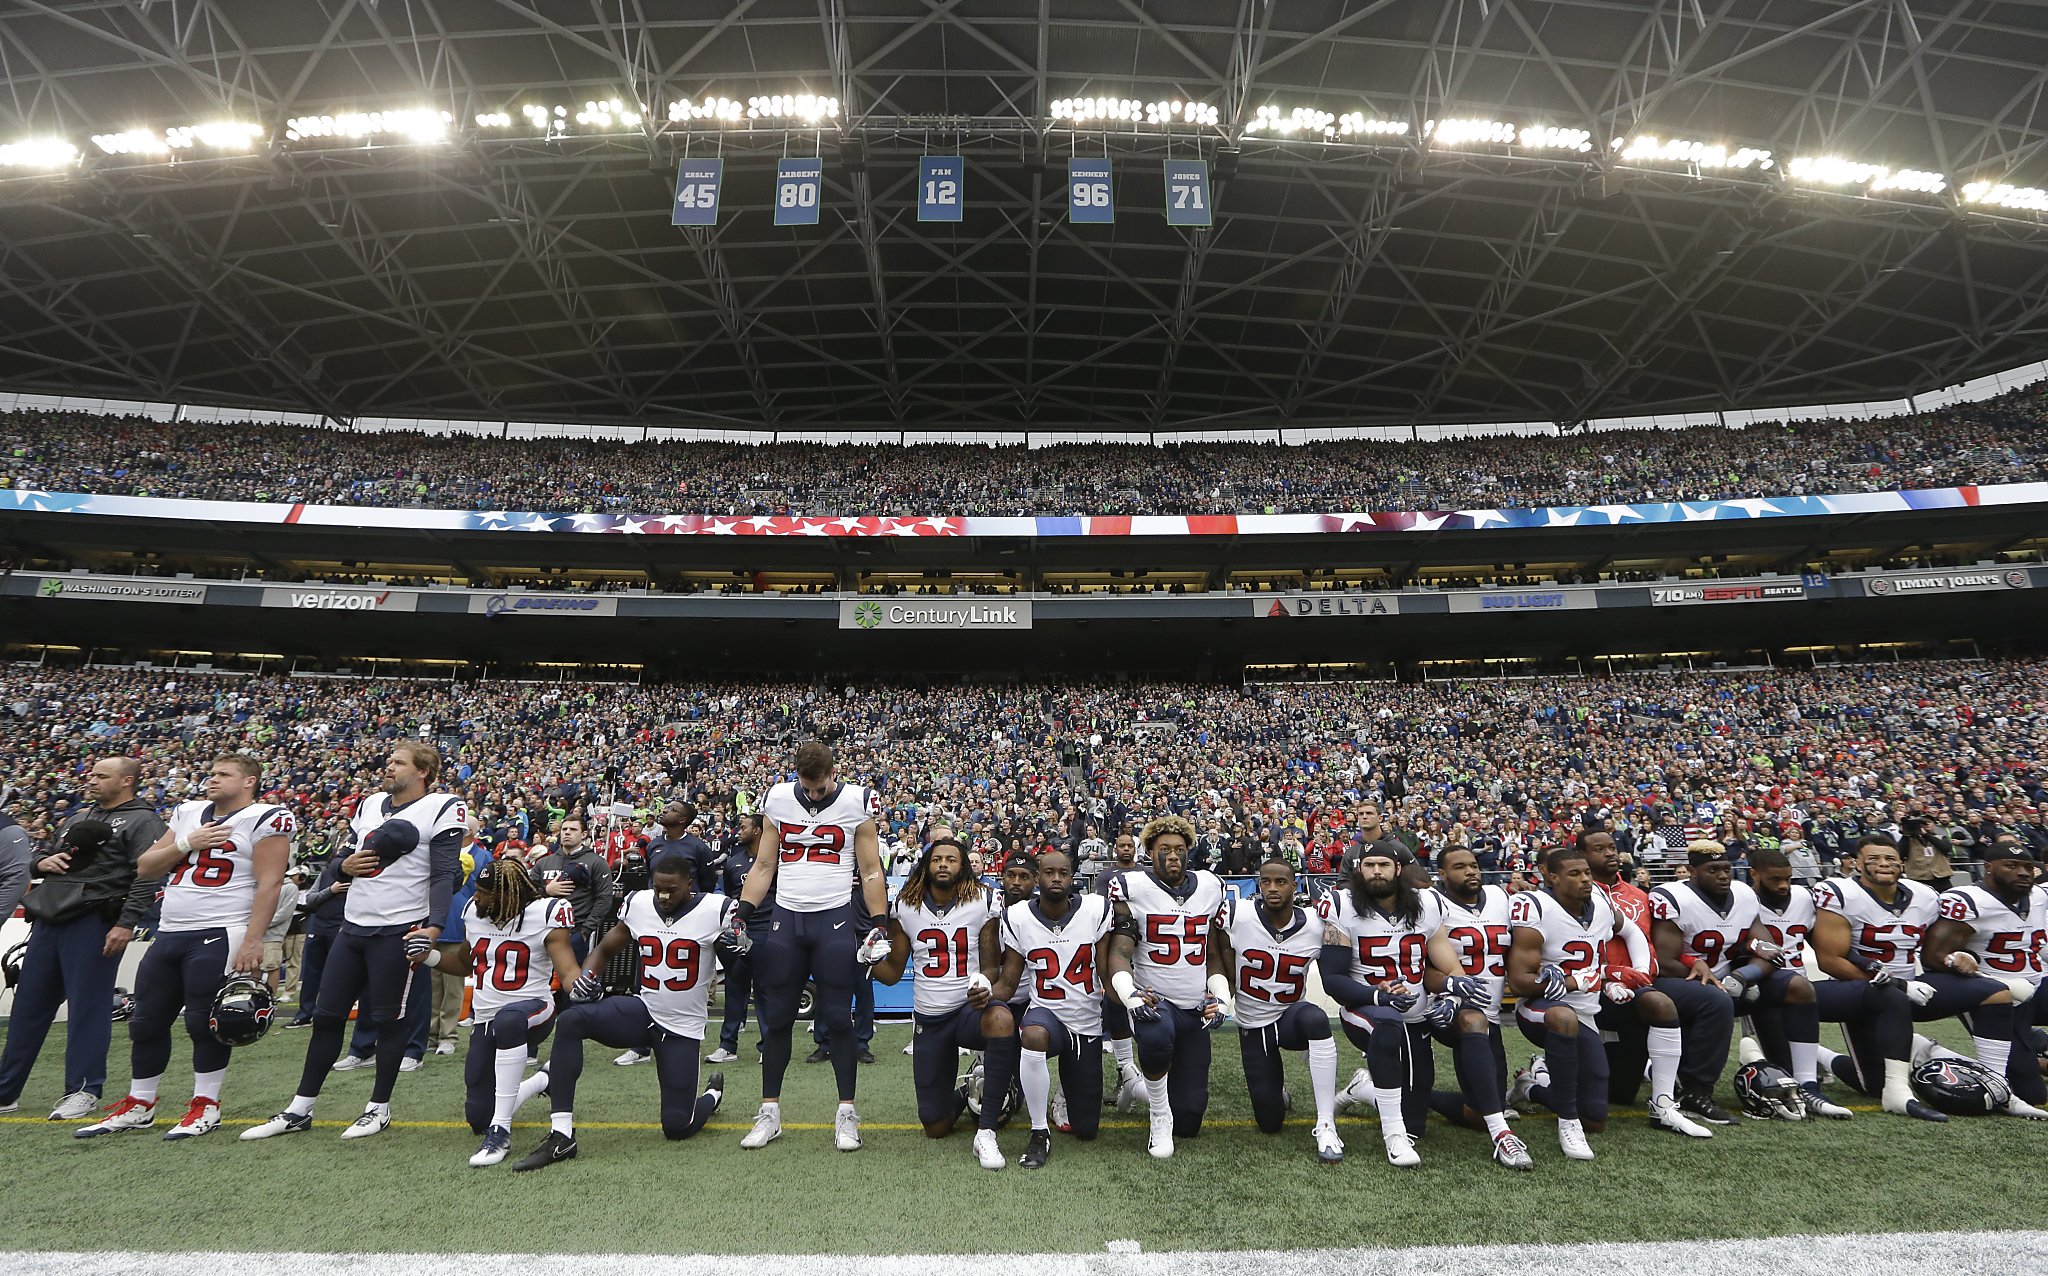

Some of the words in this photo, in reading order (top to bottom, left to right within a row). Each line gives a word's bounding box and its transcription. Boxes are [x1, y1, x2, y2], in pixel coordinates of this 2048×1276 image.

[779, 170, 820, 178] LARGENT
[931, 168, 952, 176] FAN
[677, 184, 716, 208] 45
[780, 183, 816, 208] 80
[925, 181, 956, 204] 12
[1073, 183, 1109, 207] 96
[1172, 185, 1204, 208] 71
[63, 583, 151, 596] WASHINGTON'S
[153, 587, 202, 598] LOTTERY
[1807, 574, 1824, 586] 12
[1894, 577, 1944, 592] JIMMY
[1949, 574, 2000, 589] JOHN'S
[291, 590, 377, 611] verizon
[512, 597, 599, 611] BOEING
[1482, 595, 1516, 609] BUD
[1517, 593, 1564, 608] LIGHT
[1653, 589, 1685, 603] 710
[1703, 586, 1762, 600] ESPN
[1764, 586, 1802, 595] SEATTLE
[889, 605, 1017, 627] CenturyLink
[1296, 598, 1388, 616] DELTA
[270, 816, 293, 833] 46
[456, 807, 466, 823] 9
[1696, 807, 1714, 822] 96
[711, 840, 721, 852] 10
[780, 821, 846, 864] 52
[554, 907, 575, 927] 40
[1511, 901, 1530, 921] 21
[1941, 899, 1967, 920] 58
[1146, 913, 1210, 966] 55
[1859, 923, 1927, 964] 57
[917, 926, 968, 978] 31
[1358, 933, 1428, 985] 50
[1448, 924, 1511, 977] 35
[470, 937, 530, 992] 40
[638, 935, 700, 991] 29
[1027, 943, 1094, 1000] 24
[1240, 949, 1311, 1003] 25
